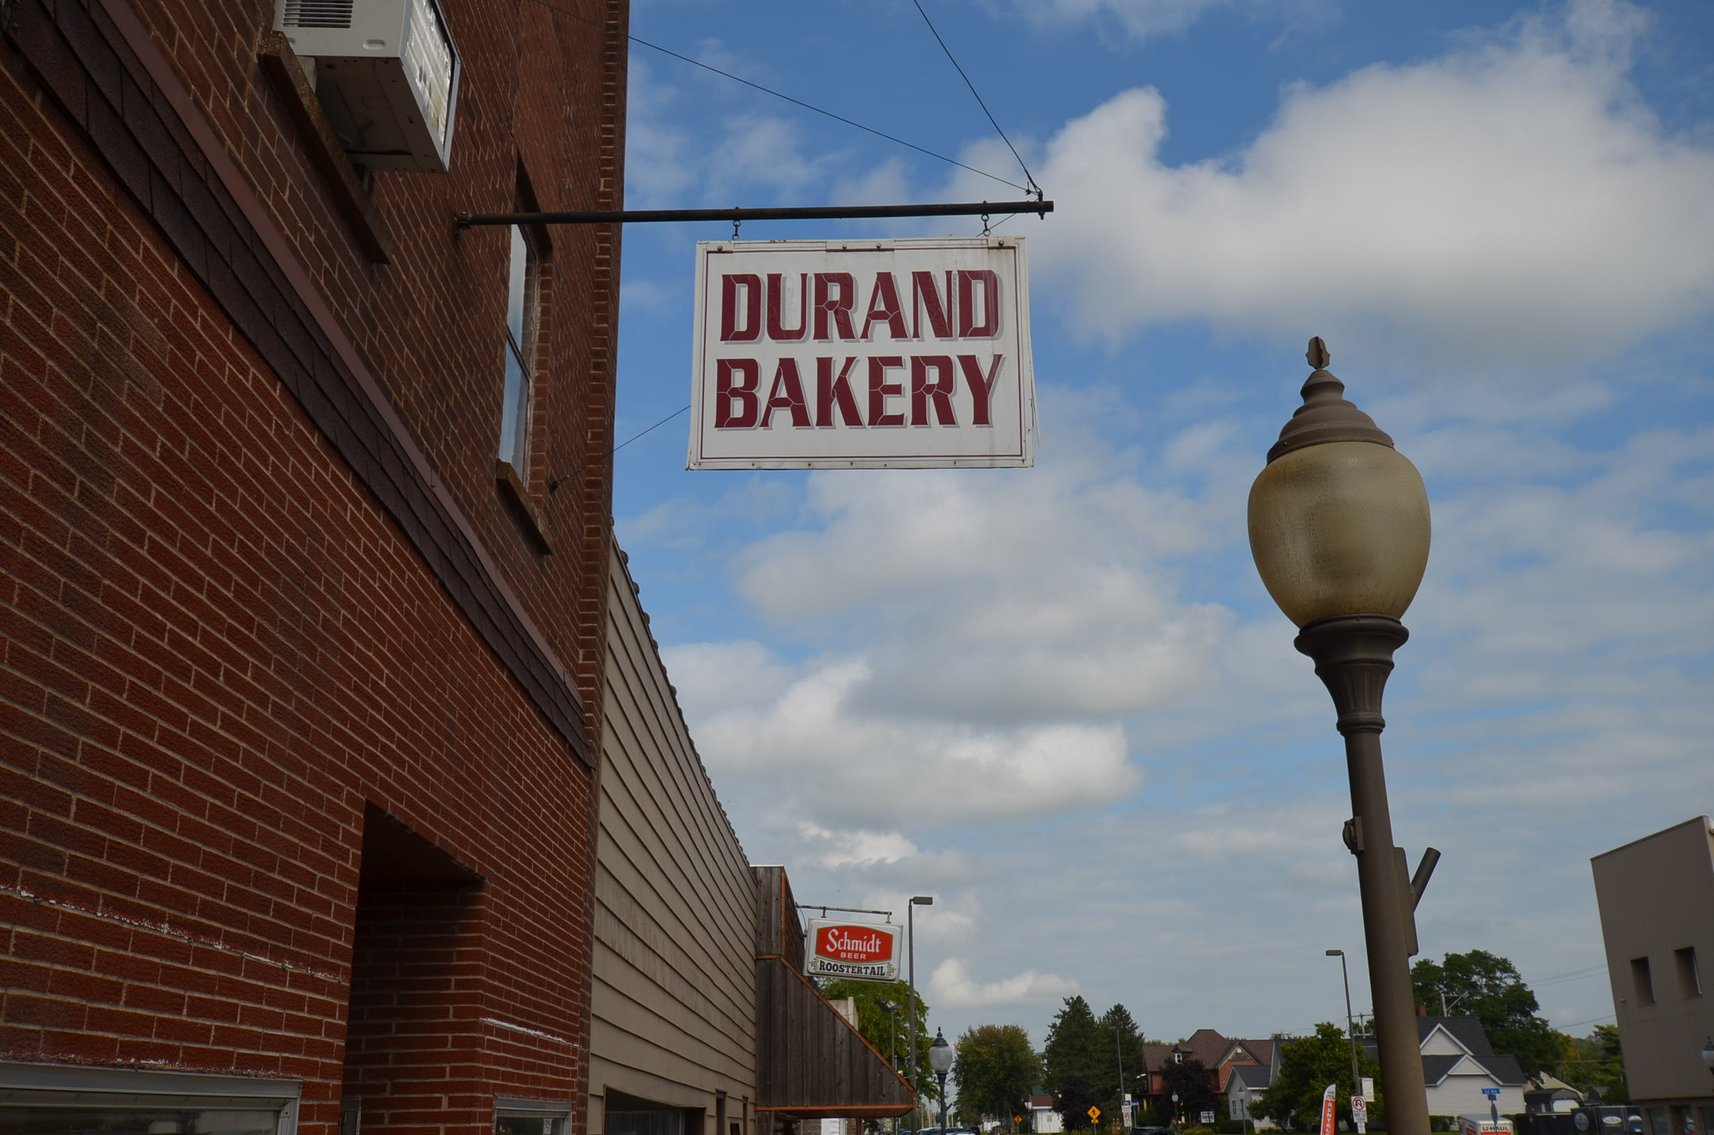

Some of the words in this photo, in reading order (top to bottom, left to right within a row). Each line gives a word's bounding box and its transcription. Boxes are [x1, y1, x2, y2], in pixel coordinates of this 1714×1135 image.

[720, 271, 1002, 343] DURAND
[714, 354, 1005, 430] BAKERY
[826, 928, 881, 953] Schmidt
[819, 960, 886, 976] ROOSTERTAIL
[840, 952, 866, 960] BEER
